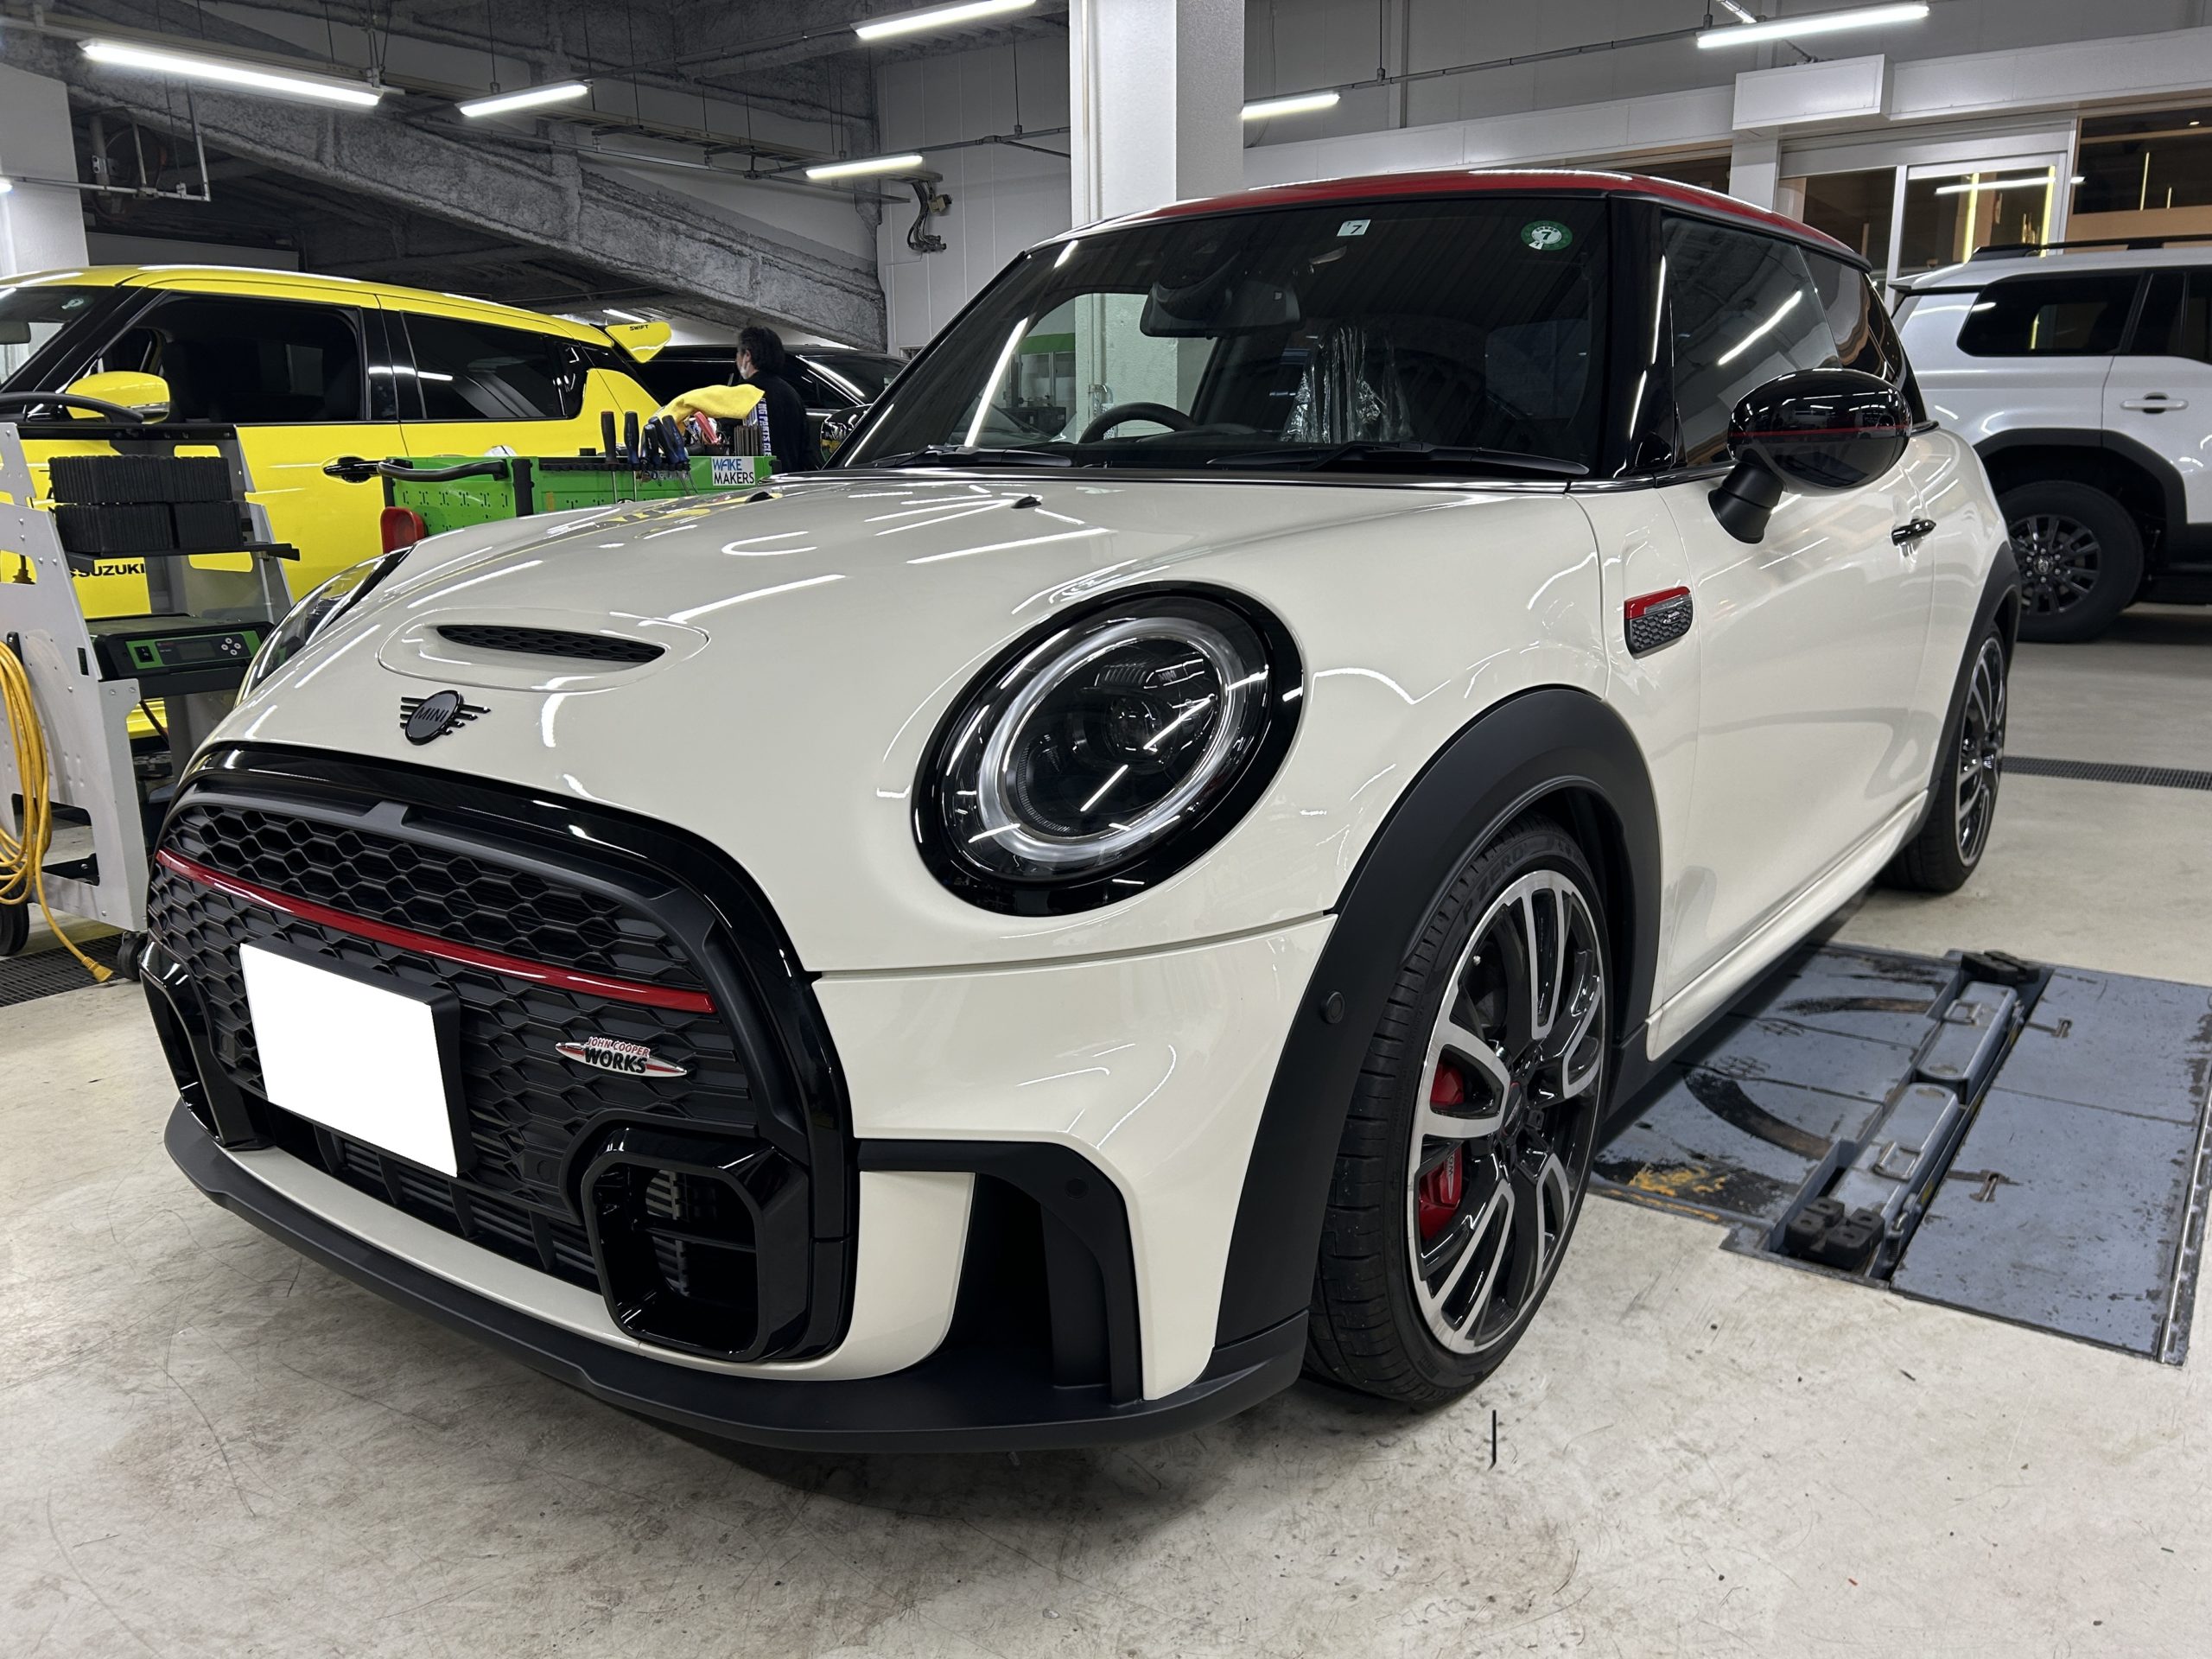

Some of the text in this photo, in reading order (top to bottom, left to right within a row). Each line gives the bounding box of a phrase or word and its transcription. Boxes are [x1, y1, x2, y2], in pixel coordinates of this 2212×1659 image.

[1351, 225, 1362, 234] 7
[1541, 231, 1552, 240] 7
[714, 472, 754, 484] MAKERS
[414, 707, 449, 722] MINI
[587, 1037, 650, 1056] JOHN COOPER
[584, 1047, 648, 1073] WORKS
